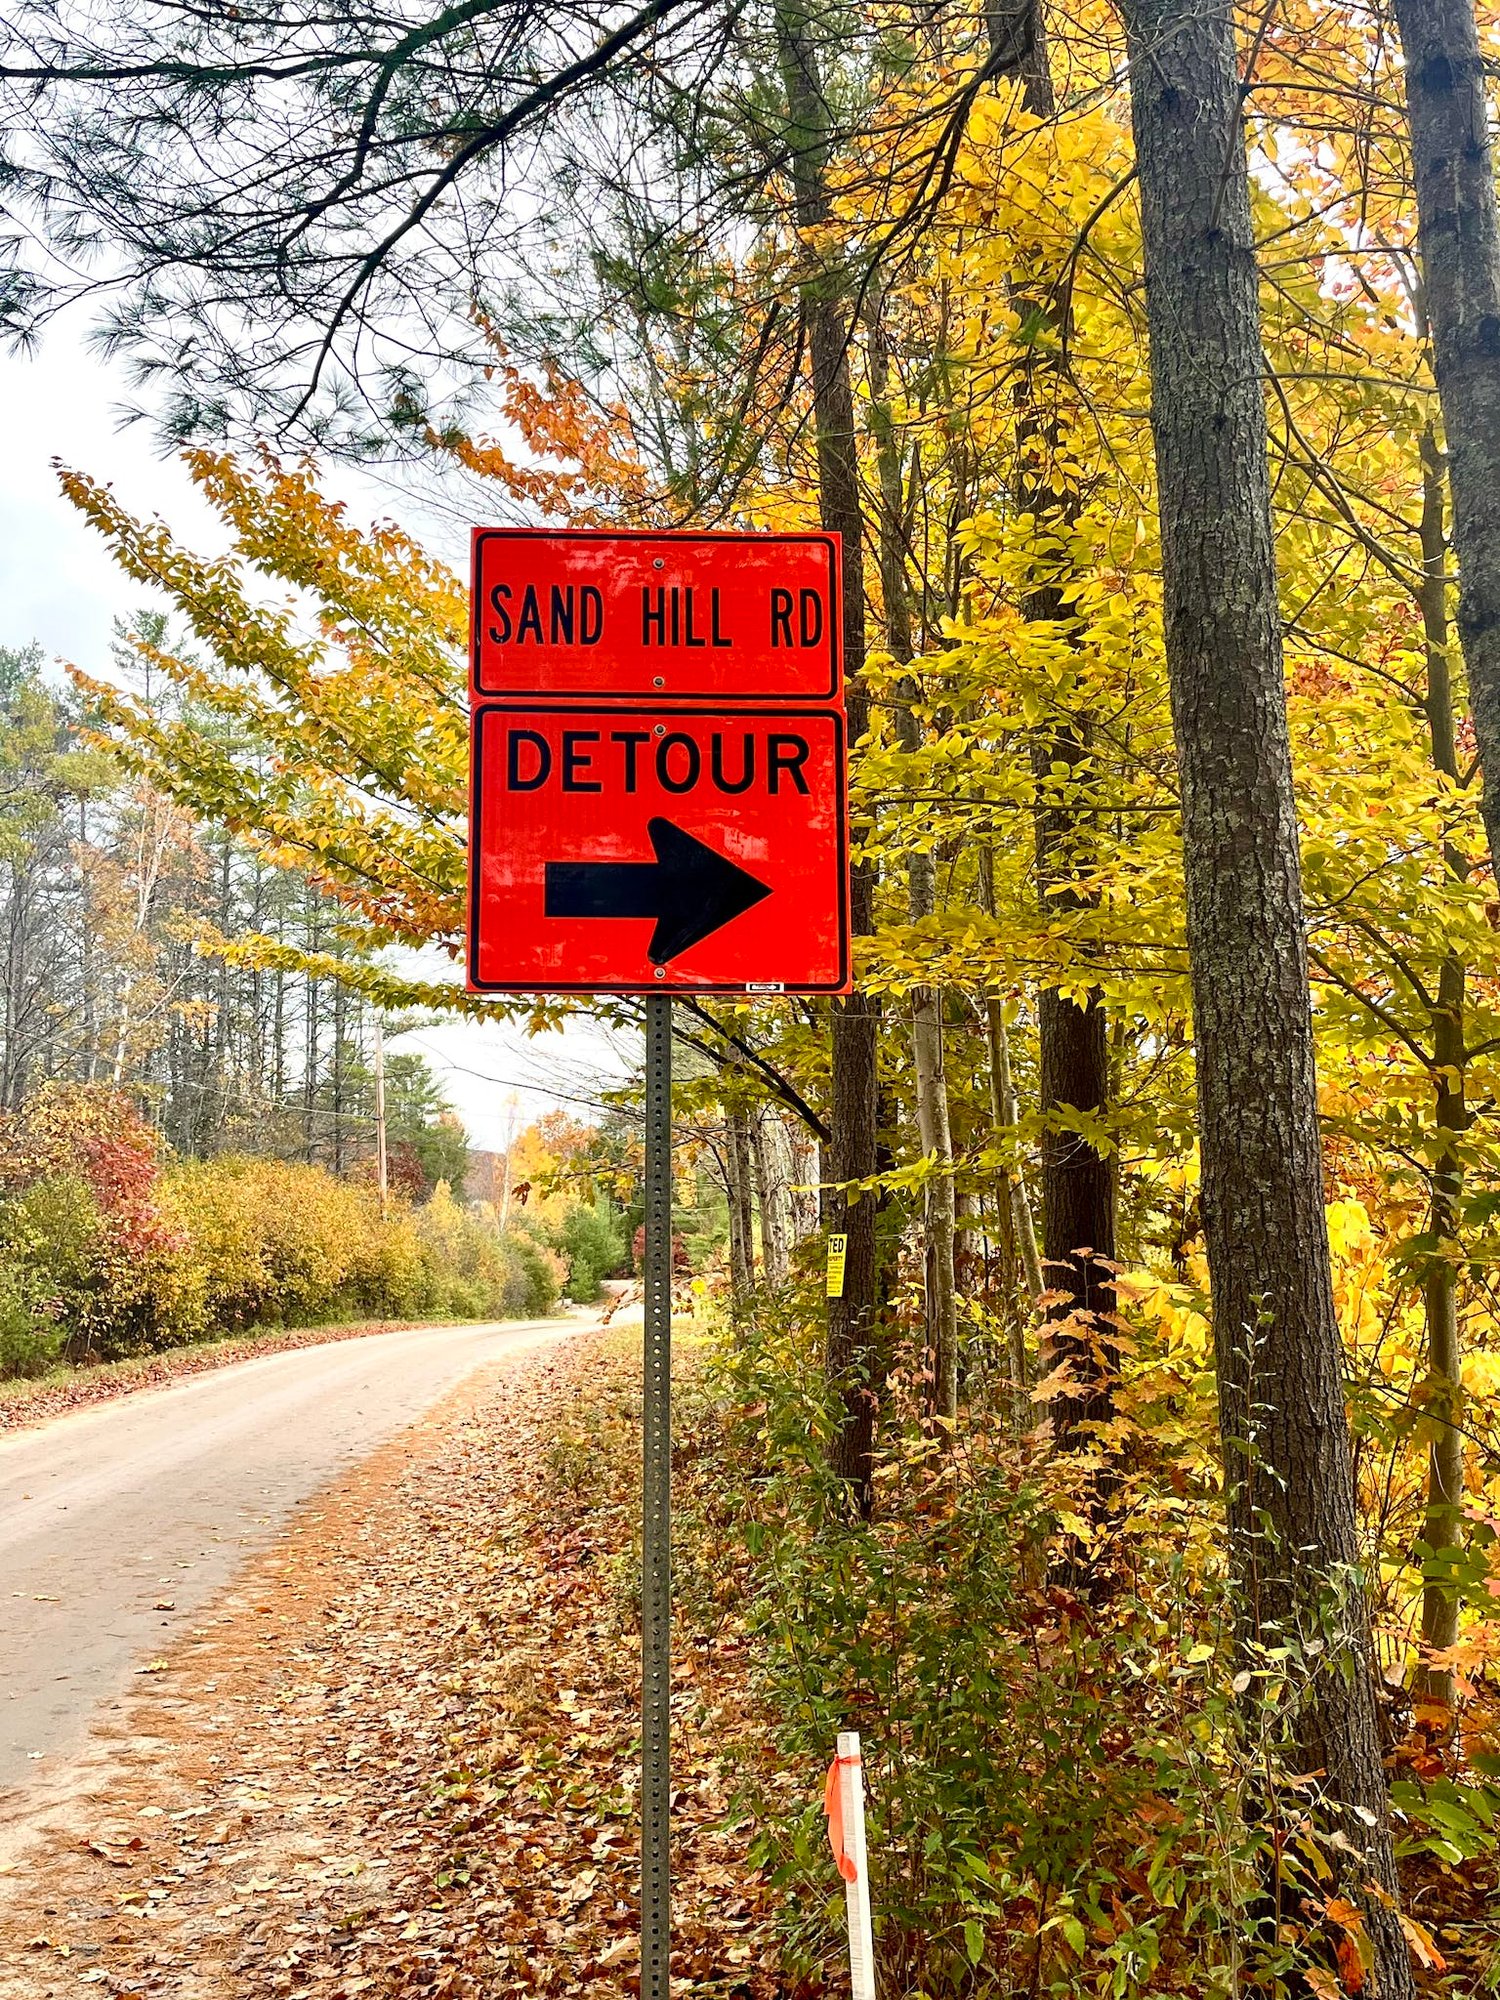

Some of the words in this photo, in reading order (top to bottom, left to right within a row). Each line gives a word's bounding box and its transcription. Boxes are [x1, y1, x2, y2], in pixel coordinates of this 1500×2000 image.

[489, 584, 603, 645] SAND
[642, 587, 732, 647] HILL
[771, 588, 823, 648] RD
[507, 730, 811, 795] DETOUR
